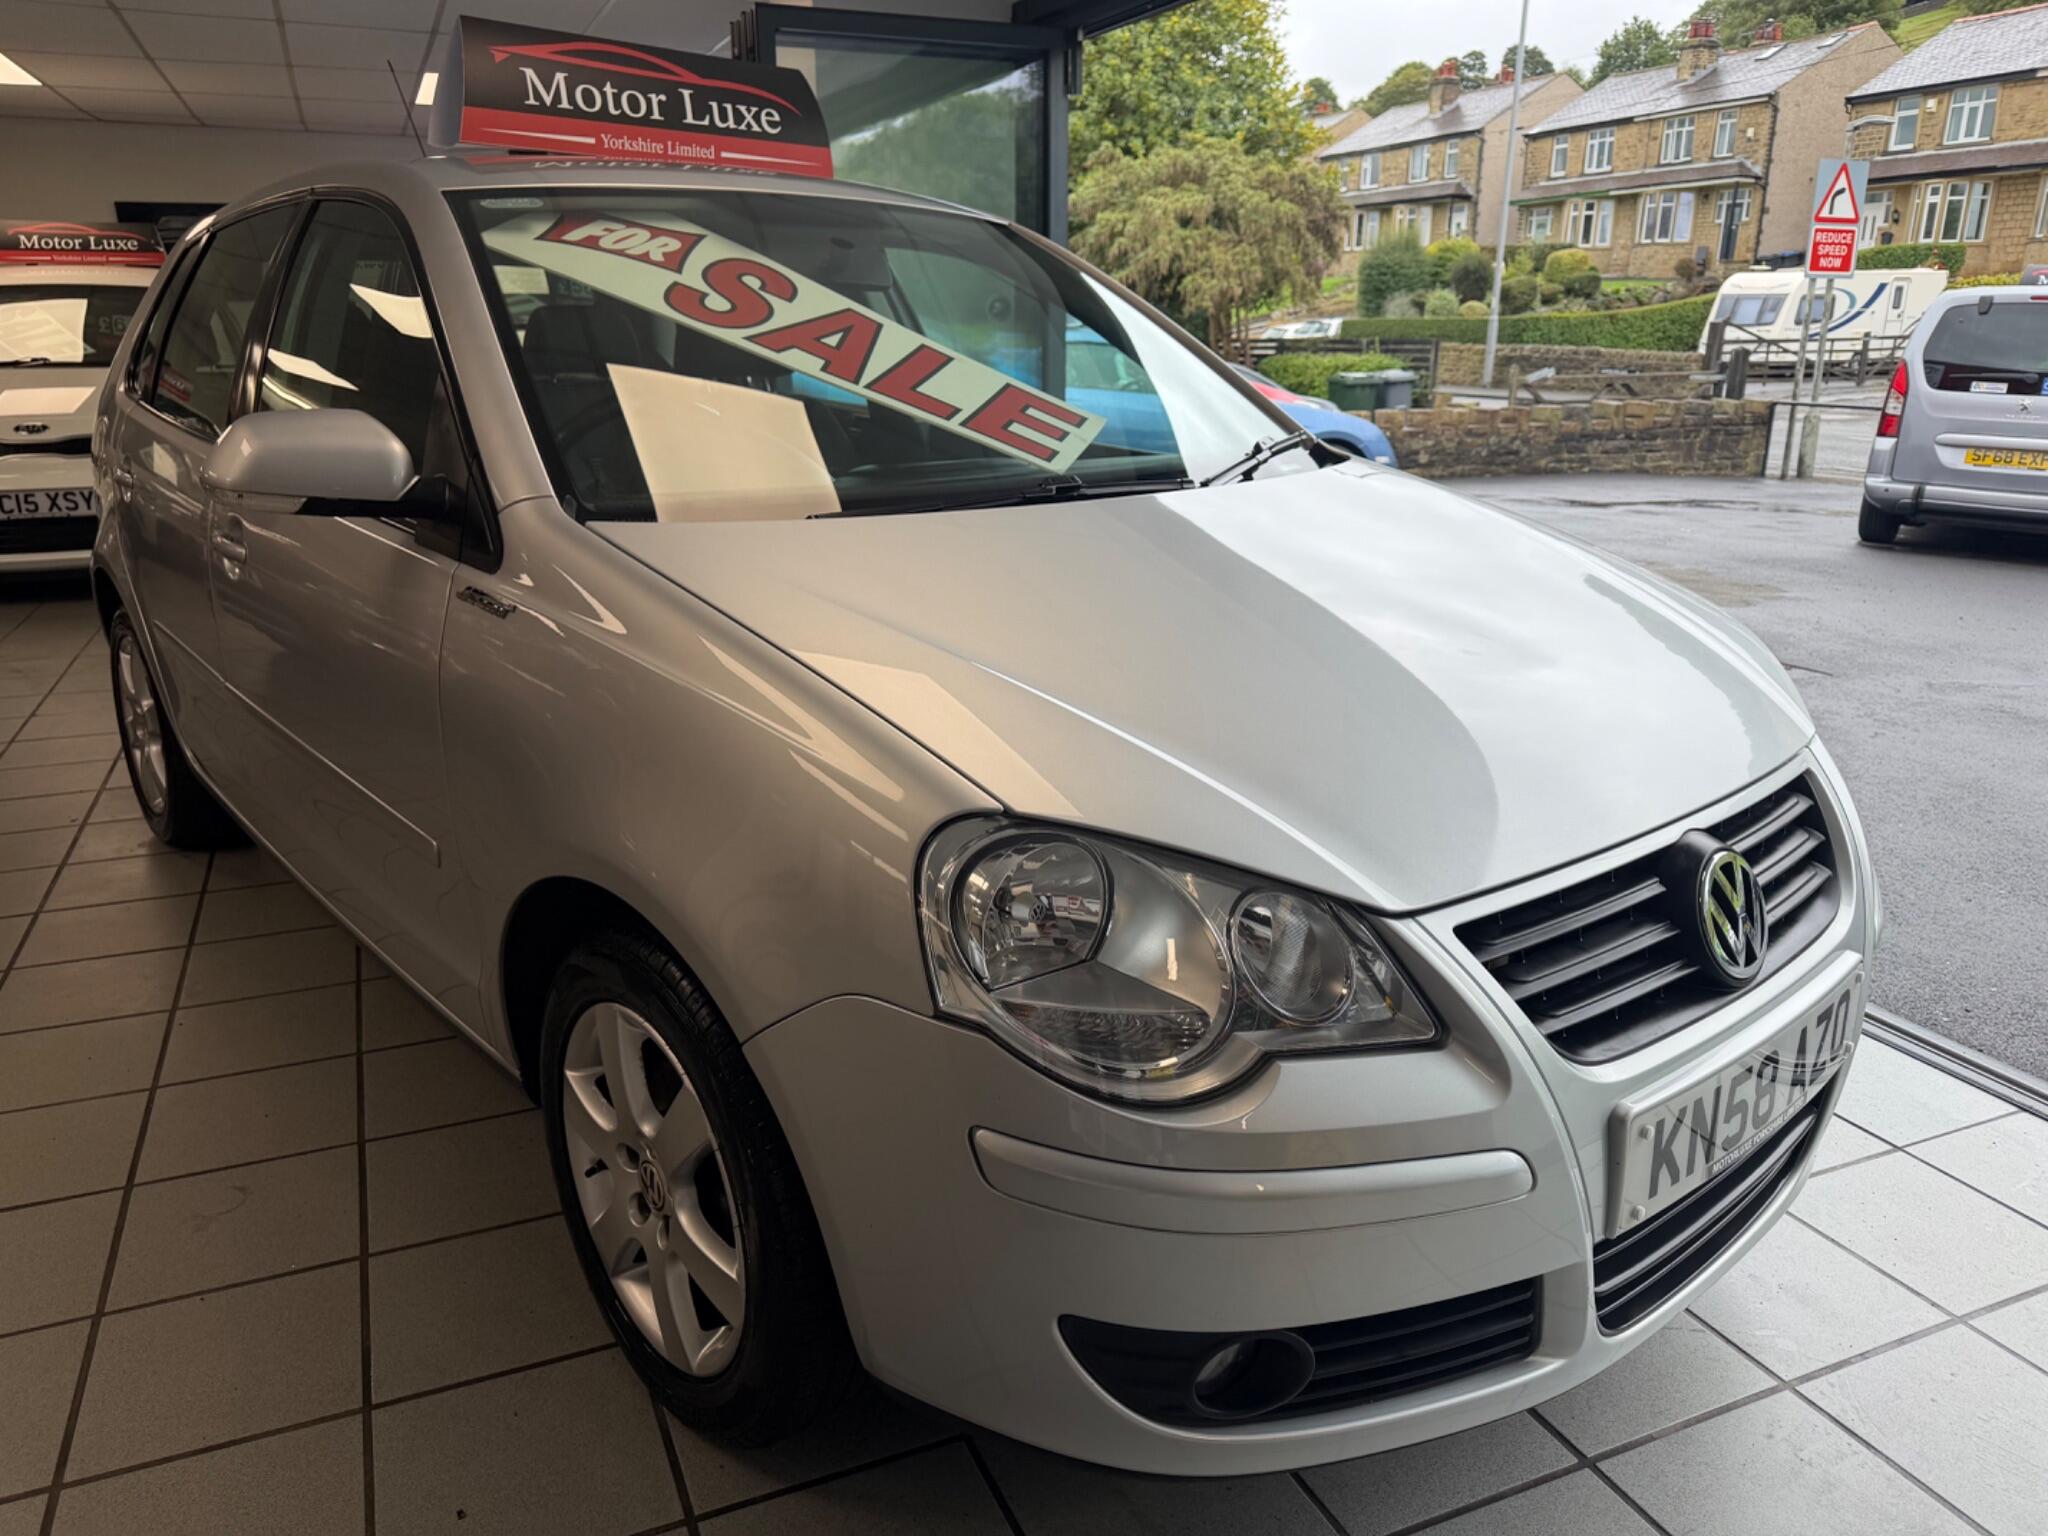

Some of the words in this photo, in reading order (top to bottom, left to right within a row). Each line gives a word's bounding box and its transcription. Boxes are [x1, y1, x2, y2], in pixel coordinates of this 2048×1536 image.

[518, 66, 667, 121] Motor
[681, 87, 783, 135] Luxe
[600, 132, 665, 155] Yorkshire
[666, 138, 716, 160] Limited
[18, 234, 82, 250] Motor
[88, 235, 139, 251] Luxe
[560, 219, 686, 263] FOR
[1815, 231, 1854, 244] REDUCE
[1817, 244, 1849, 256] SPEED
[1819, 256, 1843, 269] NOW
[662, 256, 1089, 465] SALE
[44, 490, 94, 513] XSY
[1647, 1049, 1781, 1200] KN58
